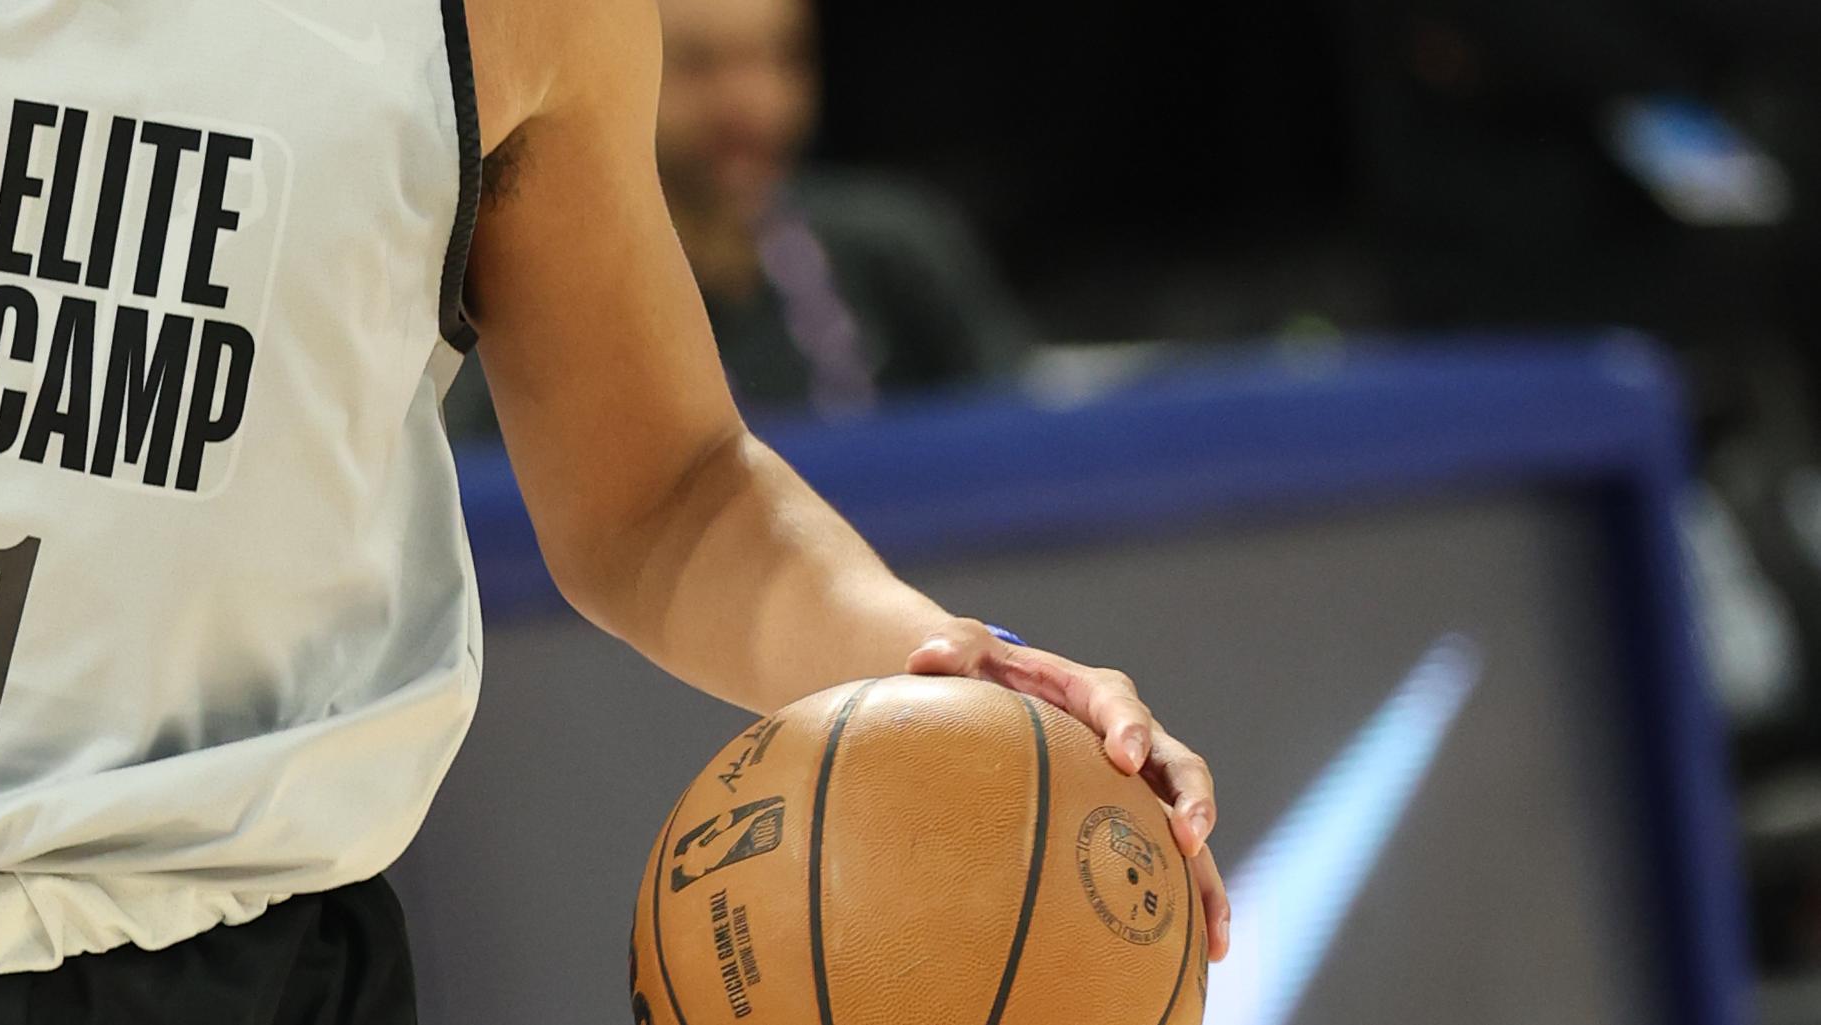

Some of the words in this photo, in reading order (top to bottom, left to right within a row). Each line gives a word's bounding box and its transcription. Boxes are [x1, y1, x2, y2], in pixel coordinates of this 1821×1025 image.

[753, 815, 777, 849] NBA
[710, 887, 728, 922] BALL
[714, 921, 734, 960] GAME
[720, 959, 752, 1019] OFFICIAL
